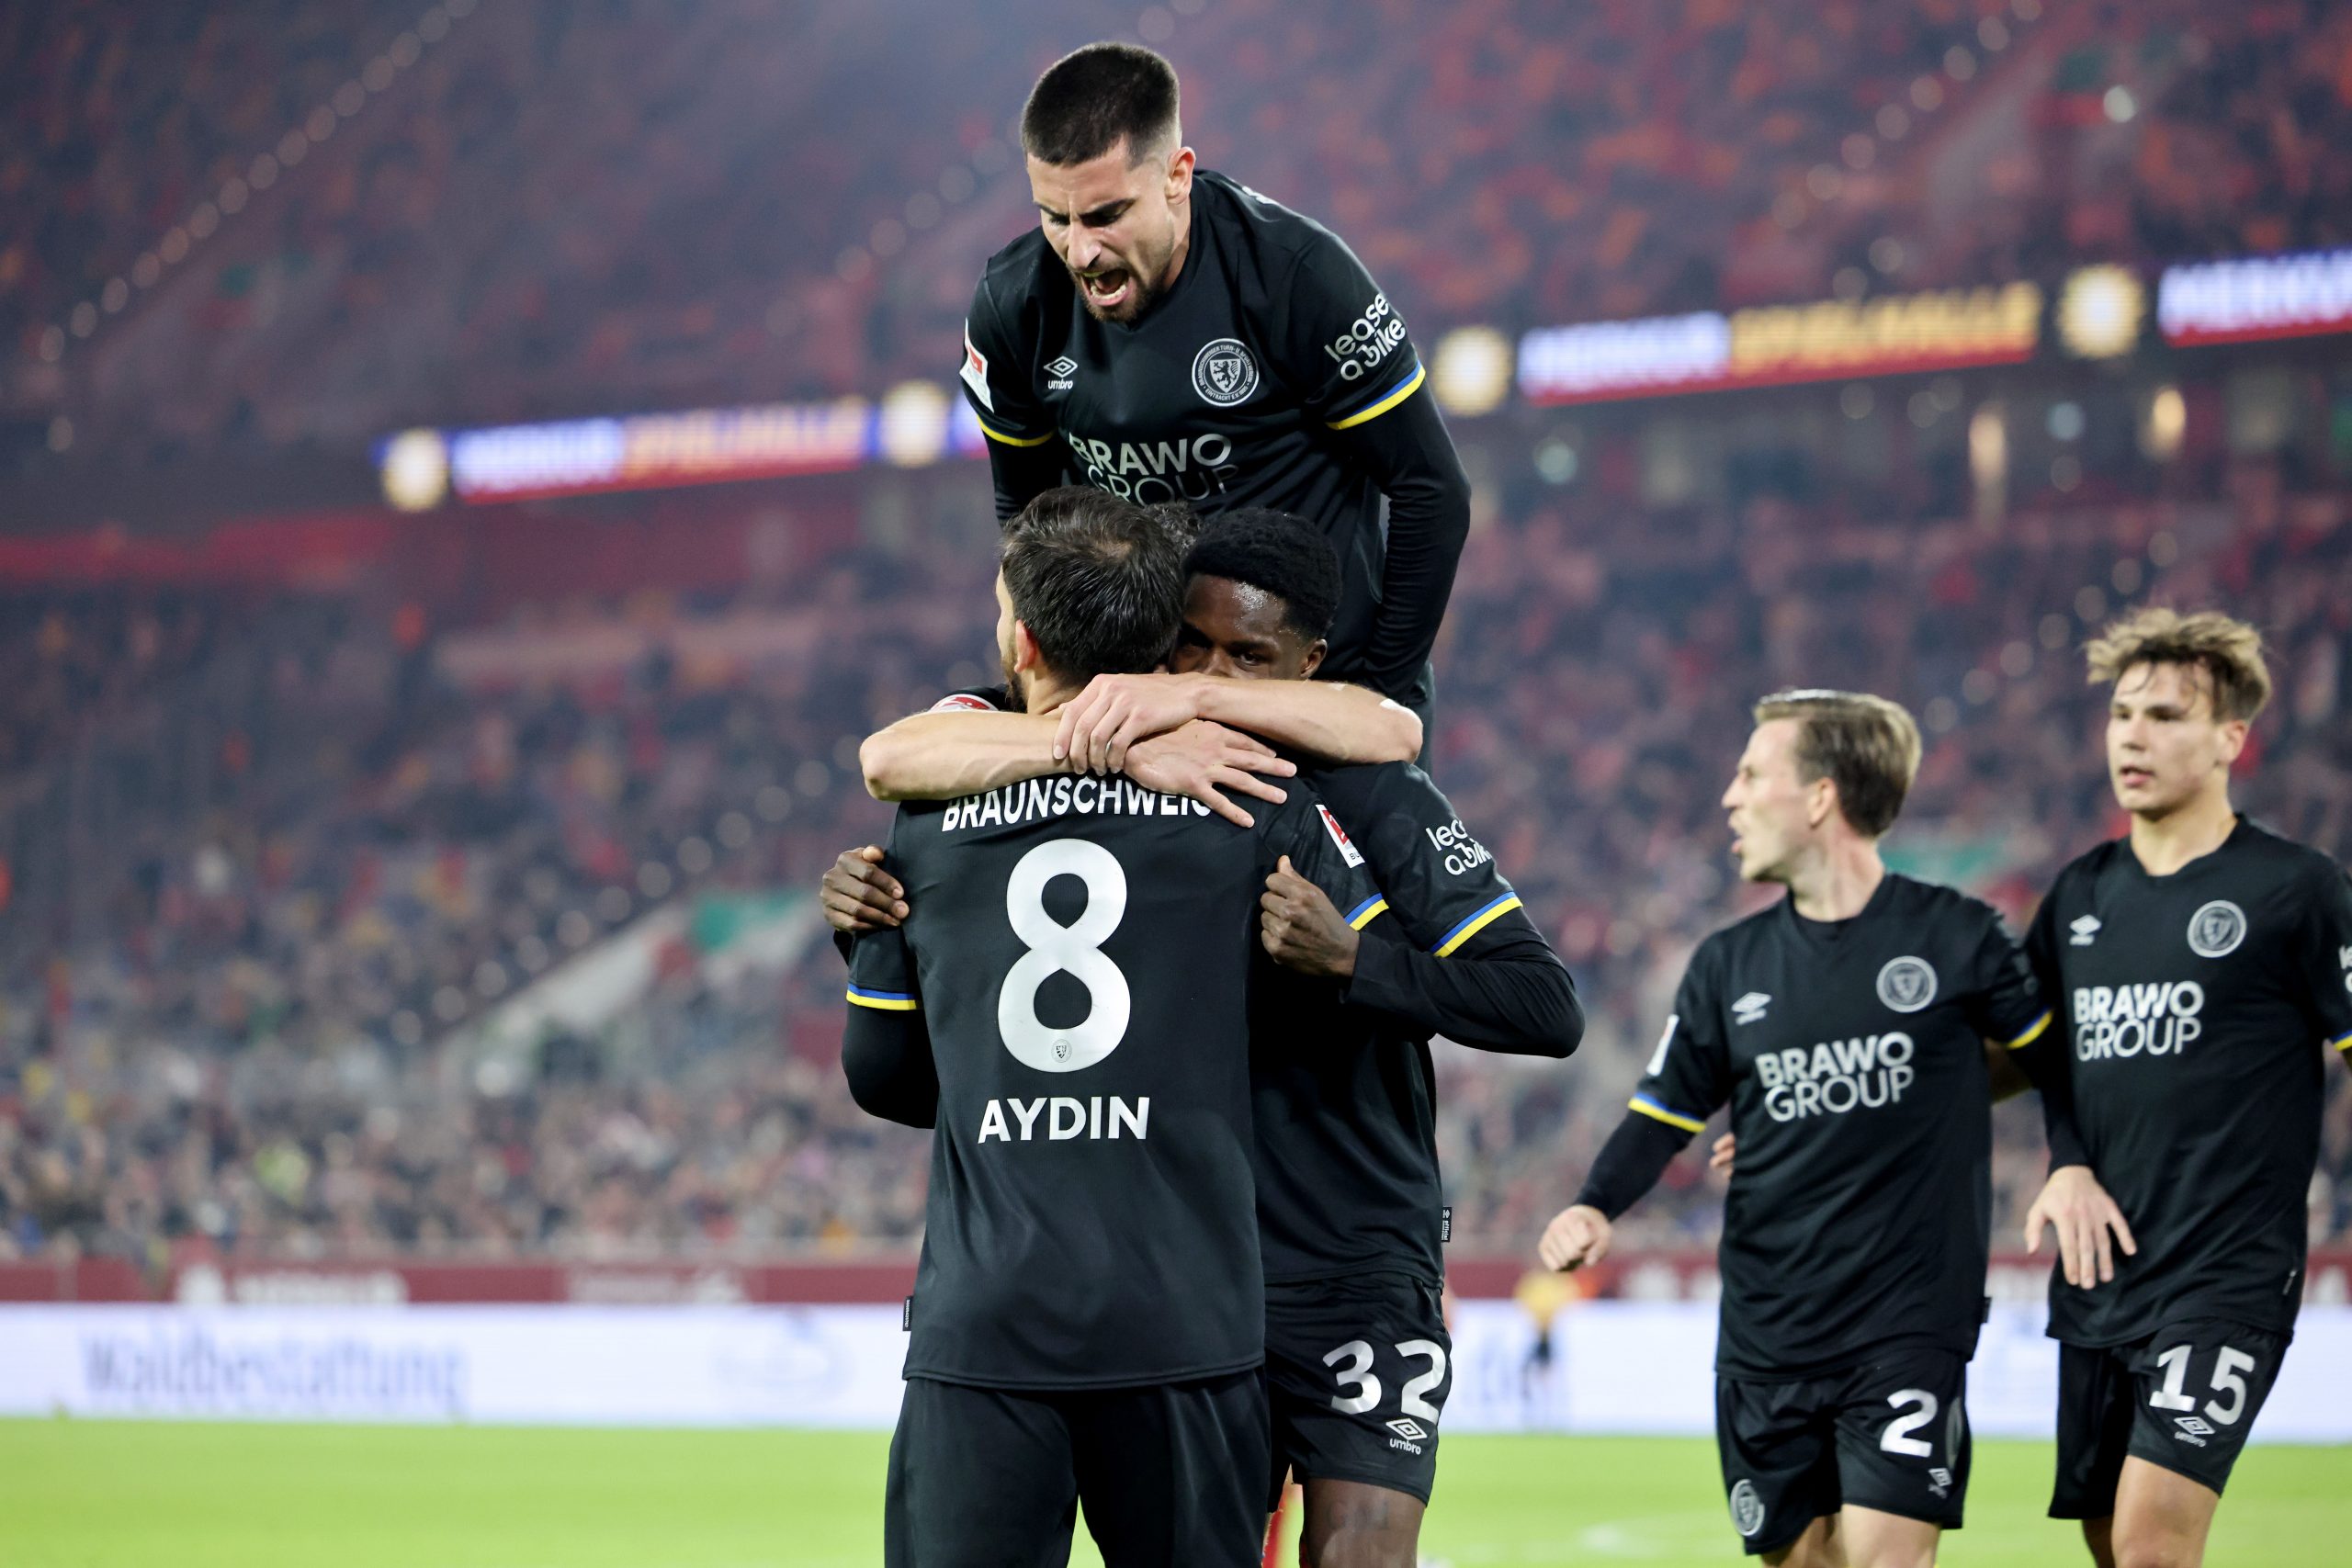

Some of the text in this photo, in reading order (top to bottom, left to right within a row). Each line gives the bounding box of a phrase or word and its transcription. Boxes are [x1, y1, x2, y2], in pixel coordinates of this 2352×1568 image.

[1324, 293, 1389, 362] lease
[1340, 319, 1406, 380] a bike
[1047, 378, 1073, 389] umbro
[1069, 432, 1232, 475] BRAWO
[1088, 464, 1239, 506] GROUP
[1426, 819, 1468, 852] lea
[1444, 854, 1466, 875] a
[998, 838, 1131, 1073] 8
[2074, 980, 2204, 1024] BRAWO
[1755, 1031, 1914, 1089] BRAWO
[2075, 1016, 2201, 1062] GROUP
[1764, 1065, 1914, 1122] GROUP
[978, 1096, 1150, 1144] AYDIN
[1323, 1338, 1446, 1426] 32
[2149, 1344, 2256, 1427] 15
[1389, 1438, 1421, 1456] umbro
[1879, 1388, 1938, 1458] 2
